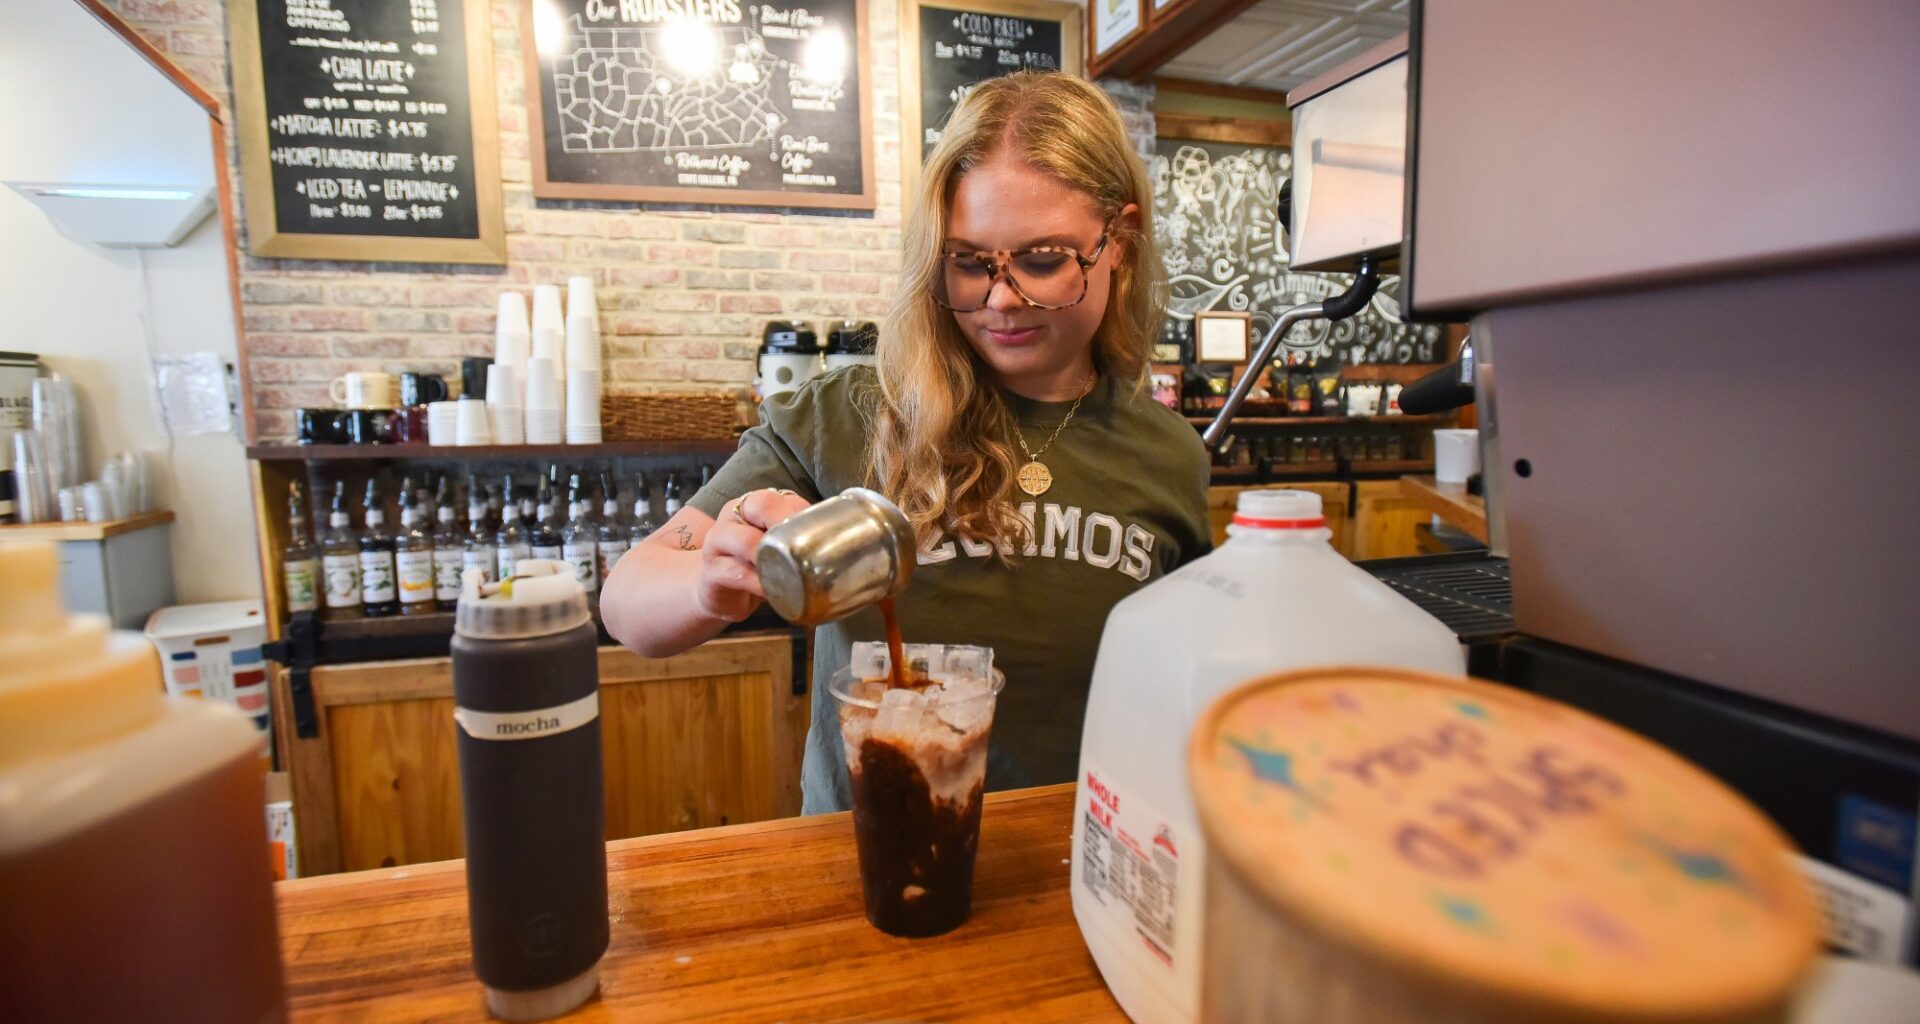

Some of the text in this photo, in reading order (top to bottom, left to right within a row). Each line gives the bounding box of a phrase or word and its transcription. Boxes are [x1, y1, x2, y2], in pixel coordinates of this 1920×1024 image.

[585, 0, 743, 23] Our ROASTERS
[960, 13, 1025, 39] COLD BREW
[331, 56, 405, 82] CHAI LATTE
[278, 114, 333, 136] MATCHA
[387, 119, 428, 139] $4.75
[277, 147, 321, 168] HONEY
[321, 148, 382, 171] LAVENDER
[420, 152, 458, 174] $5.75
[306, 178, 339, 199] ICED
[338, 179, 367, 200] TEA
[384, 179, 449, 202] LEMONADE
[496, 717, 560, 735] mocha
[1087, 770, 1121, 815] WHOLE
[1090, 797, 1113, 832] MILK
